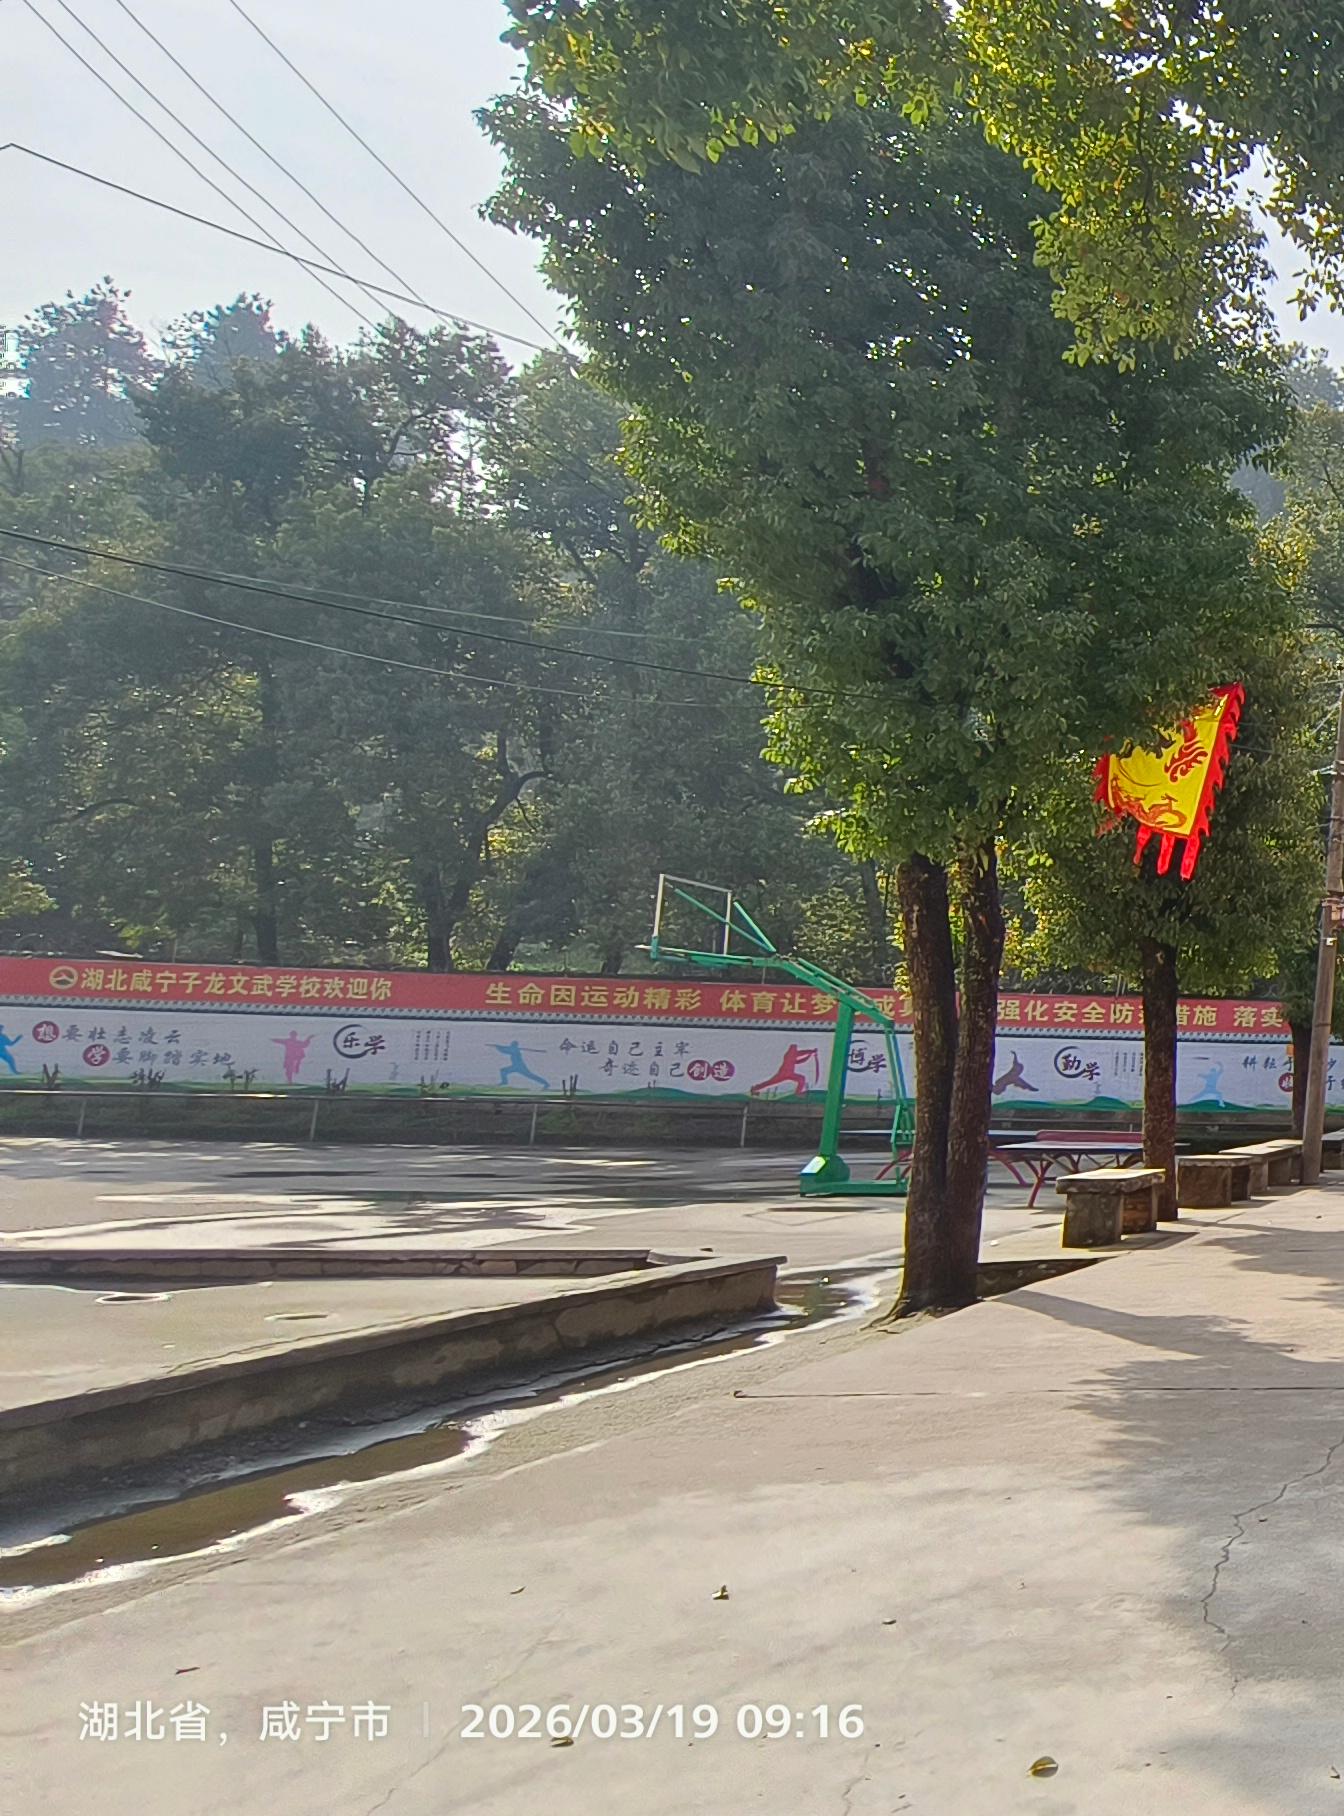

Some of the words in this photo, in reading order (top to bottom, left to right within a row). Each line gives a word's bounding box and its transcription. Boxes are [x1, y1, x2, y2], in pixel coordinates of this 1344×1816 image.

[80, 967, 392, 1001] 湖北咸宁子龙文武学校欢迎你
[485, 982, 702, 1011] 生命因运动精彩
[720, 987, 914, 1018] 体育让梦成
[997, 999, 1218, 1029] 强化安全防措施
[1233, 1005, 1284, 1029] 落实
[37, 1022, 182, 1045] 想要壮志凌云
[342, 1031, 386, 1055] 乐学
[86, 1044, 236, 1068] 学要脚踏实地
[559, 1038, 693, 1056] 命运自己主宰
[600, 1057, 732, 1080] 奇迹自己创造
